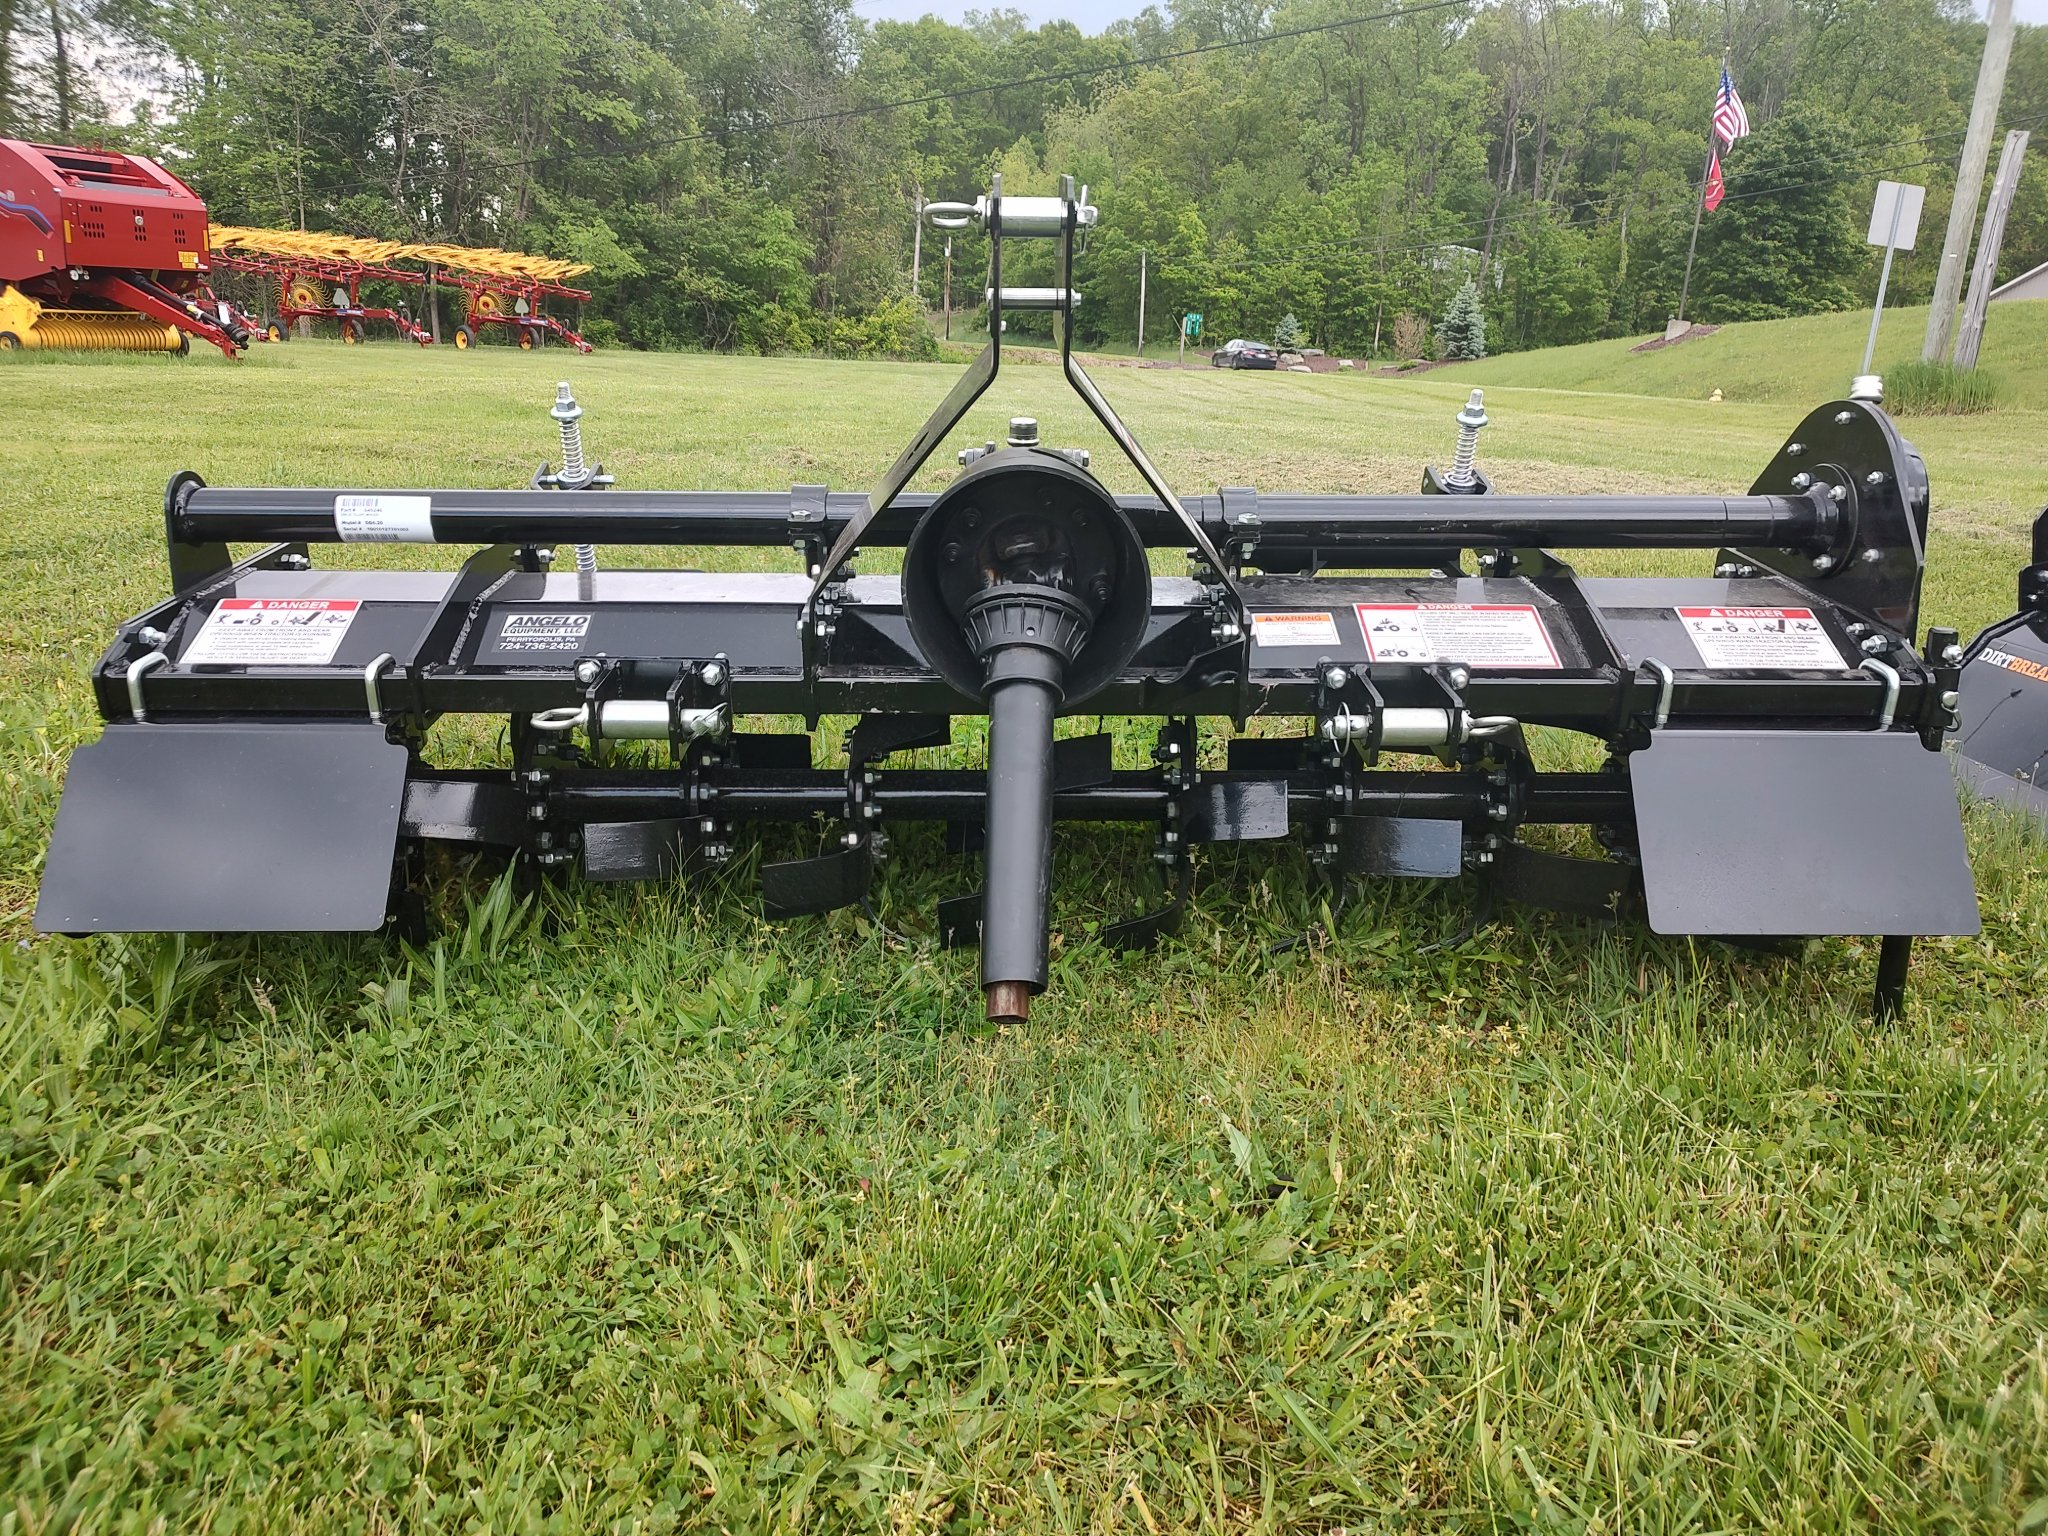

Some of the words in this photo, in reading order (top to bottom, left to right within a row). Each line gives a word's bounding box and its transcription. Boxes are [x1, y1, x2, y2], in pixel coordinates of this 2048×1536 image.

[267, 601, 330, 609] DANGER
[1725, 609, 1785, 617] DANGER
[508, 616, 588, 627] ANGELO
[499, 642, 579, 650] 724-736-2420
